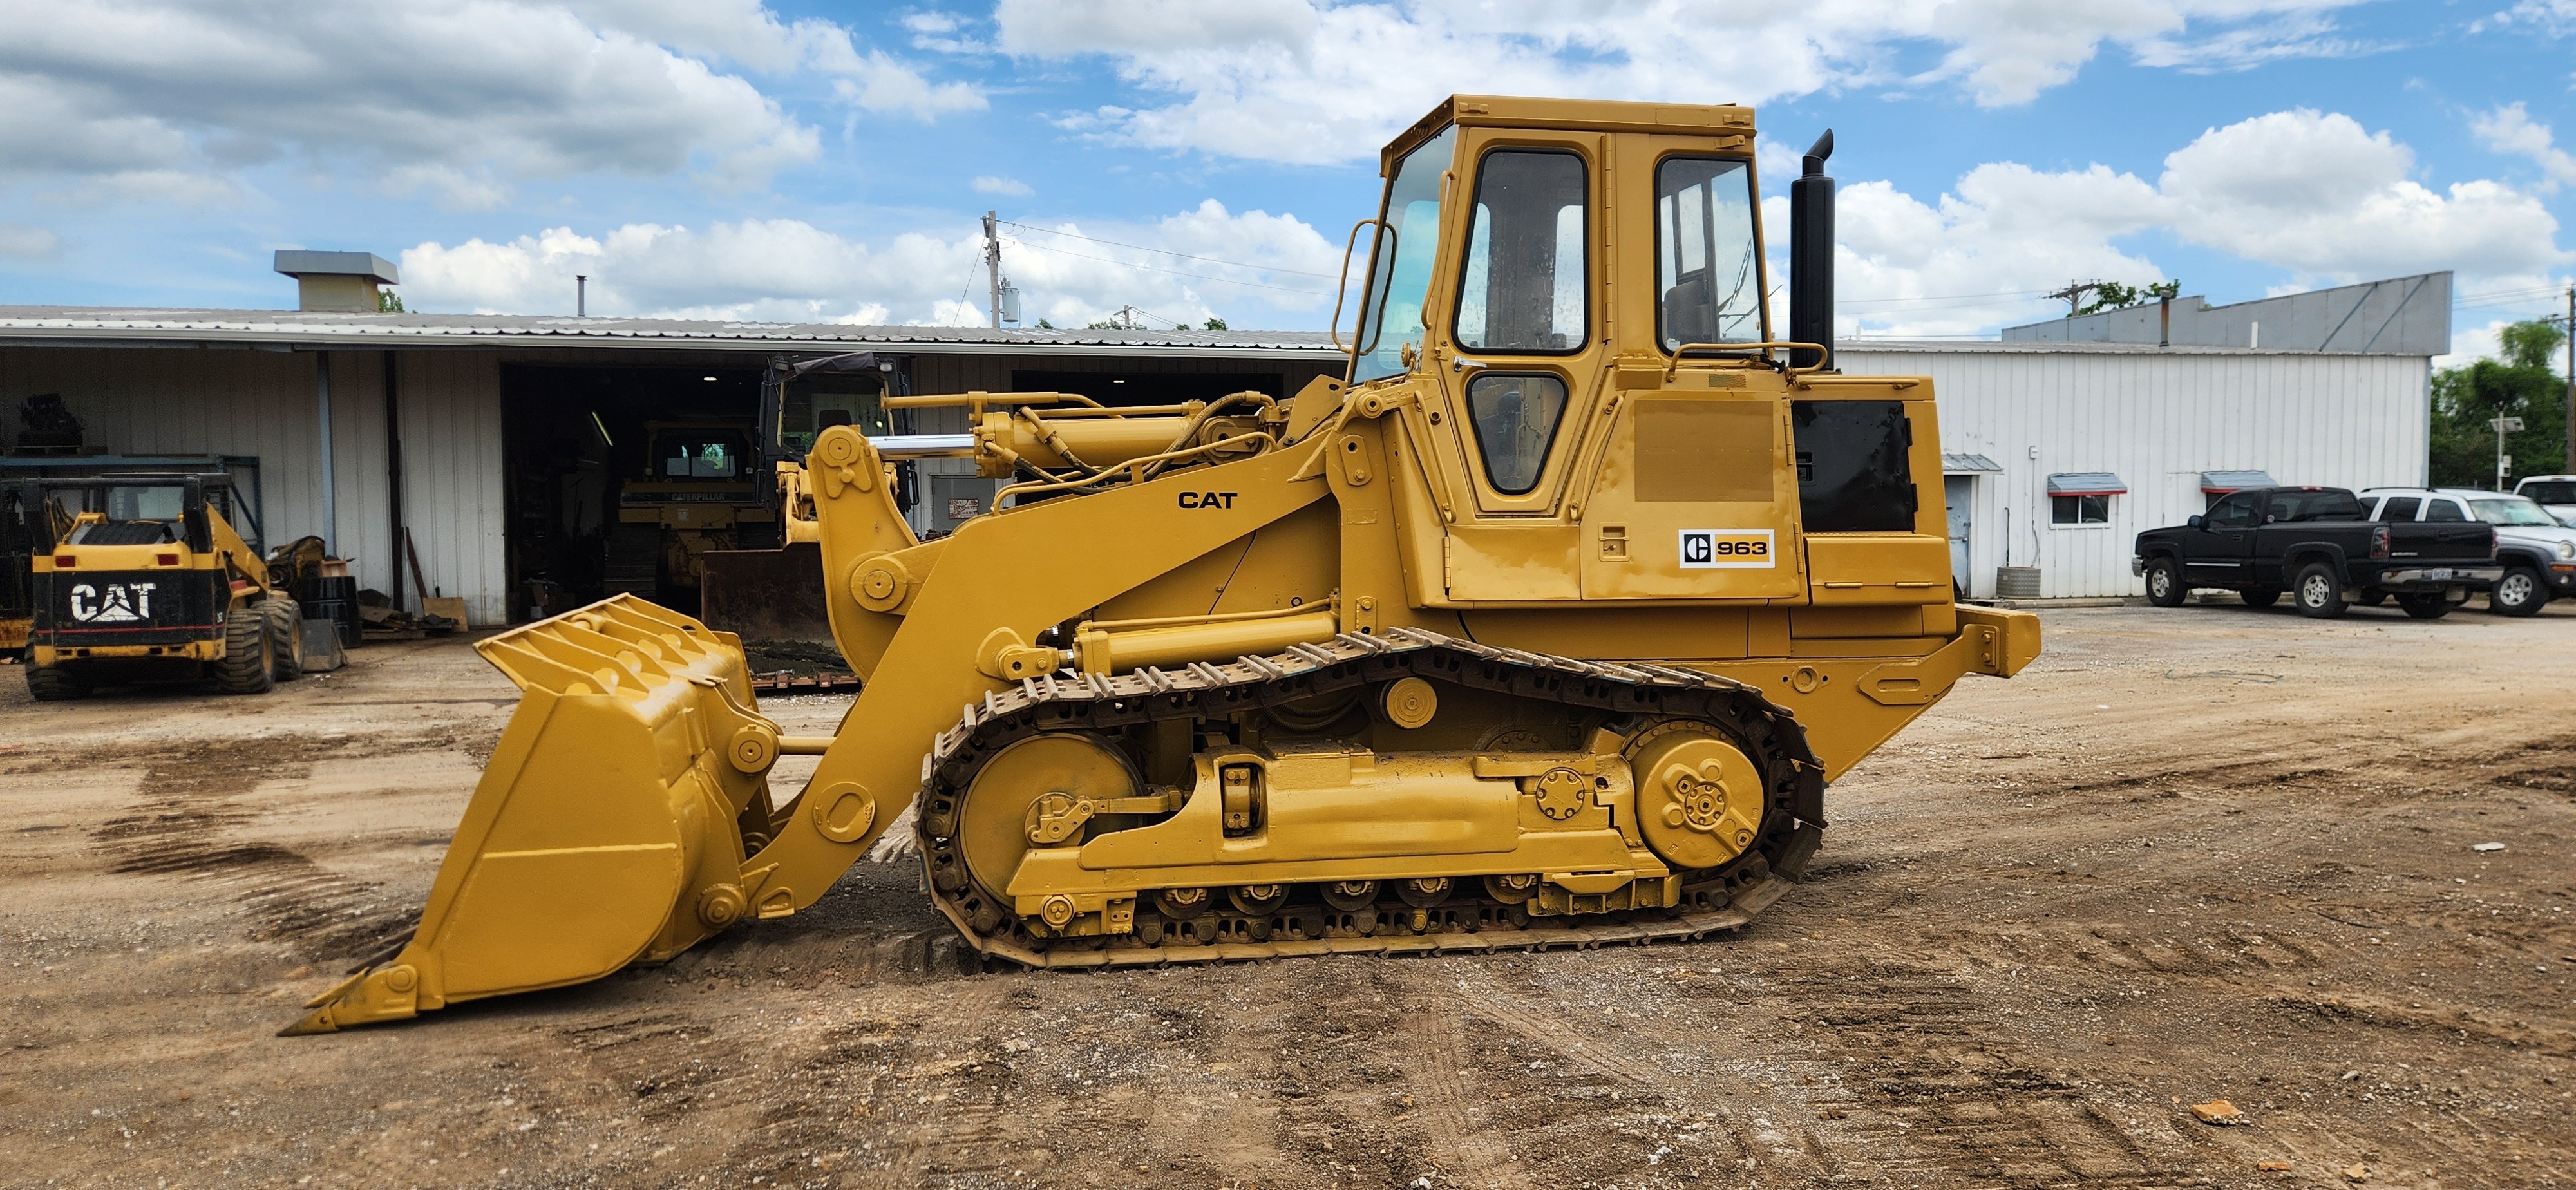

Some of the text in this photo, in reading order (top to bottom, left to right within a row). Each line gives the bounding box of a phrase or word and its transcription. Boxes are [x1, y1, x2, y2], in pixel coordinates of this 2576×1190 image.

[1179, 492, 1238, 509] CAT
[1718, 542, 1768, 555] 963
[71, 583, 156, 622] CAT
